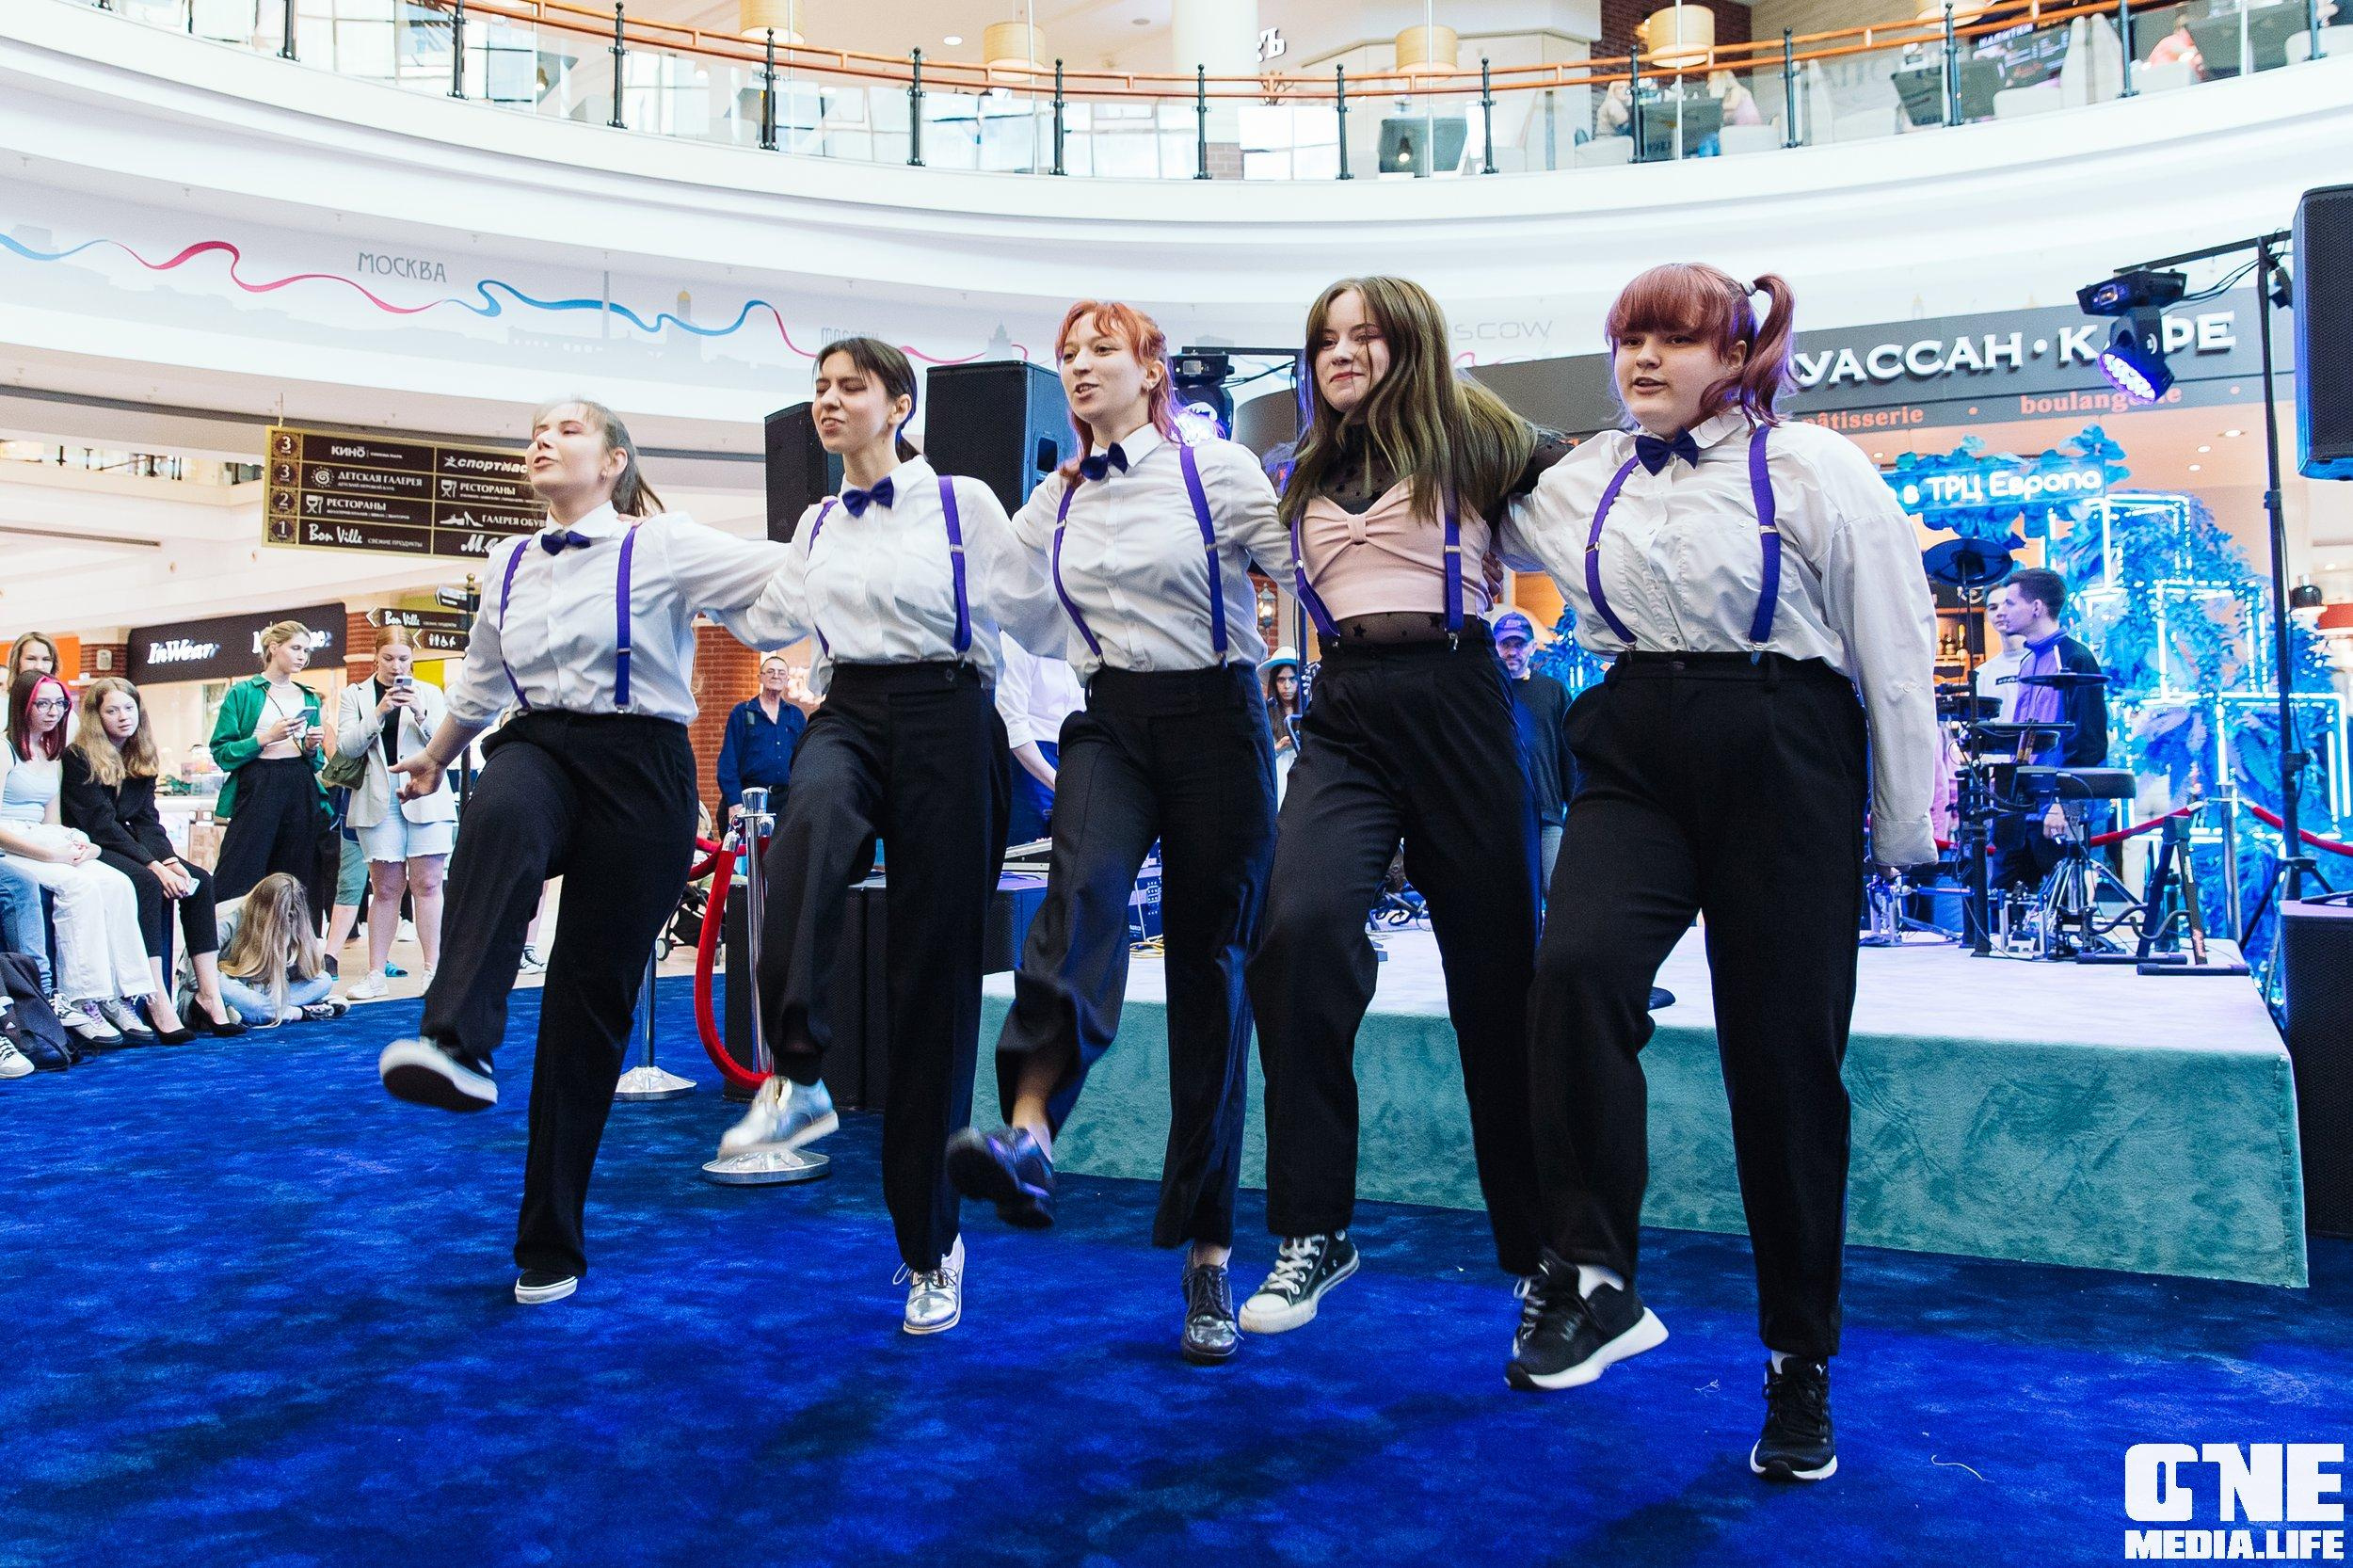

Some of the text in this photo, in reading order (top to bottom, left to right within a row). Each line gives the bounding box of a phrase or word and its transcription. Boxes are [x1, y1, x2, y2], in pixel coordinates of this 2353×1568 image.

[358, 251, 447, 283] МОСКВА
[1454, 320, 1553, 340] SCOW
[1787, 310, 2237, 388] УАССАН КФЕ
[2020, 386, 2183, 414] boulange
[281, 435, 292, 451] 3
[280, 464, 290, 479] 3
[457, 457, 528, 473] спортмас
[338, 471, 423, 488] ДЕТСКАЯ ГАЛЕРЕЯ
[1926, 473, 1984, 503] ТРЦ
[1989, 470, 2103, 501] Европа
[460, 482, 516, 496] РЕСТОРАНЫ
[279, 492, 289, 506] 2
[327, 498, 387, 511] РЕСТОРАНЫ
[279, 520, 286, 535] 1
[481, 514, 547, 528] ГАЛЕРЕЯ ОБУВ
[309, 522, 363, 545] Bon Ville
[147, 638, 215, 664] InWear
